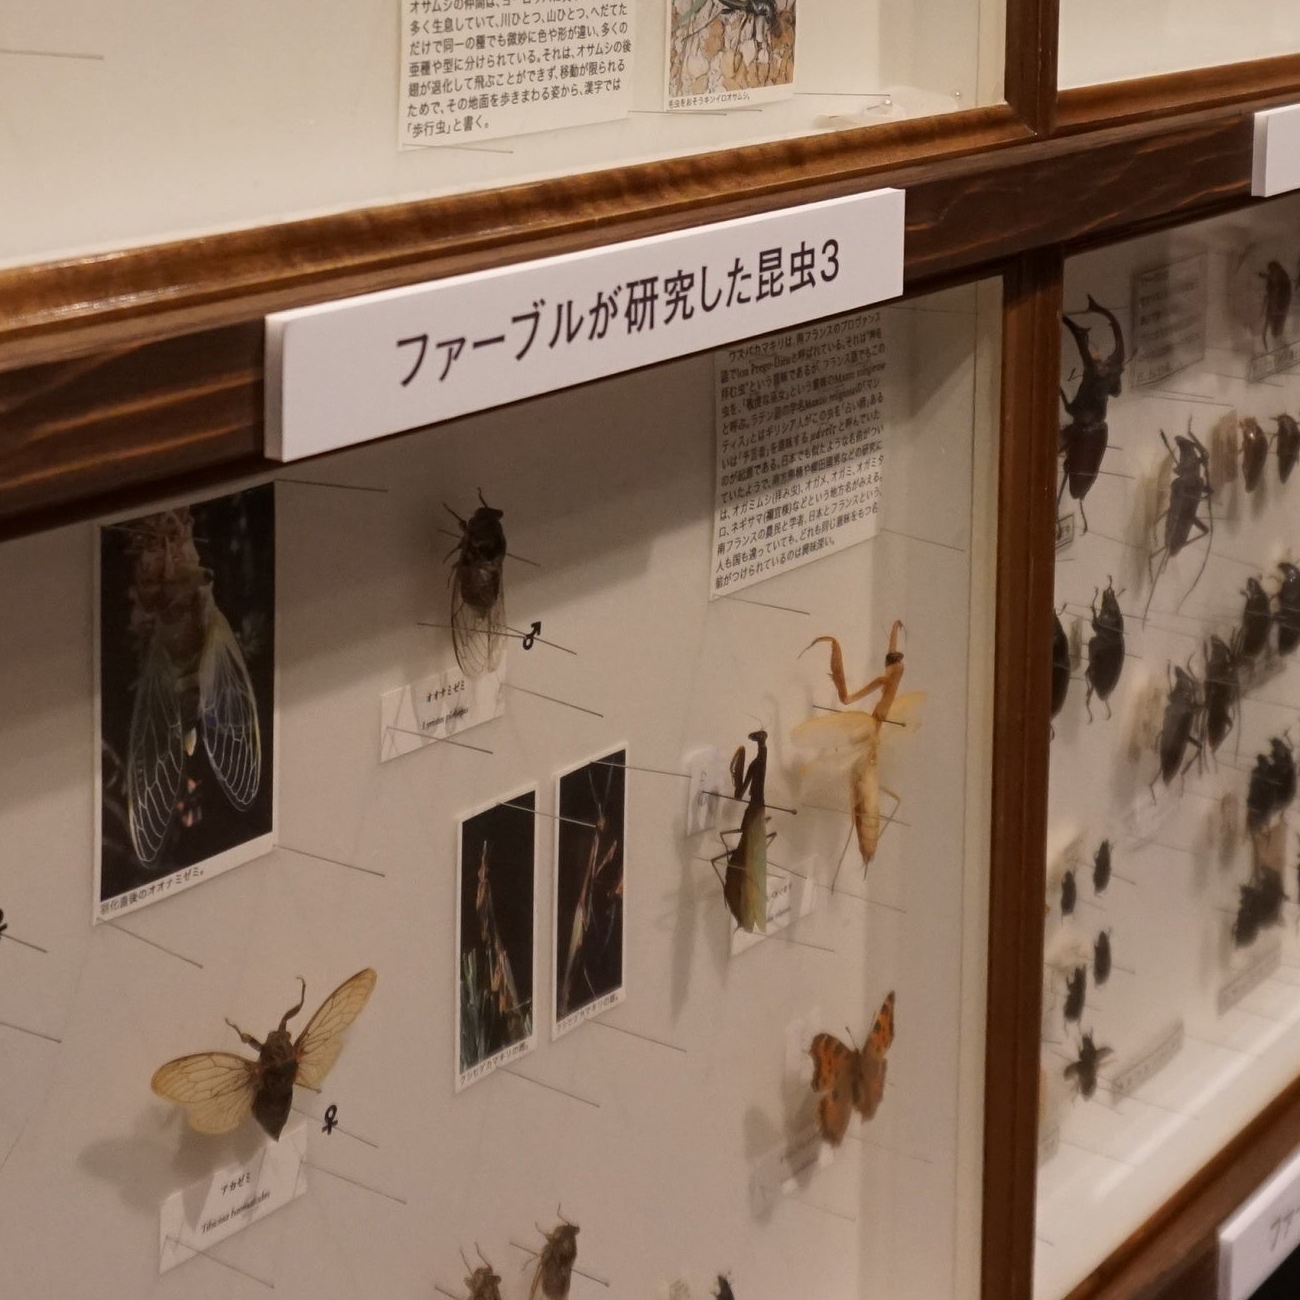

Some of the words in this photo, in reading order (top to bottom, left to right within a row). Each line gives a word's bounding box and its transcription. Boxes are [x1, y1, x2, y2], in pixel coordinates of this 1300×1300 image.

[410, 2, 627, 36] 多く生息していて、川ひとつ、山ひとつ、へだてた
[409, 22, 627, 56] だけで同一の種でも微妙に色や形が違い、多くの
[408, 40, 631, 77] 亜種や型に分けられている。それは、オサムシの後
[408, 59, 625, 98] 翅が退化して飛ぶことができず、移動が限られる
[407, 79, 621, 117] ためで、その地面を歩きまわる姿から、漢字では
[669, 91, 750, 108] 毛虫をおそうキンイロオサムシ。
[407, 115, 489, 138] 「歩行虫」と書く。
[397, 238, 841, 387] ファーブルが研究した昆虫3
[716, 502, 878, 573] 人も国も違っていても、どれも同じ意味をもつ名
[426, 681, 465, 702] オオナミゼミ
[100, 867, 203, 915] 羽化直後のオオナミゼミ。
[221, 1173, 250, 1195] アカゼミ
